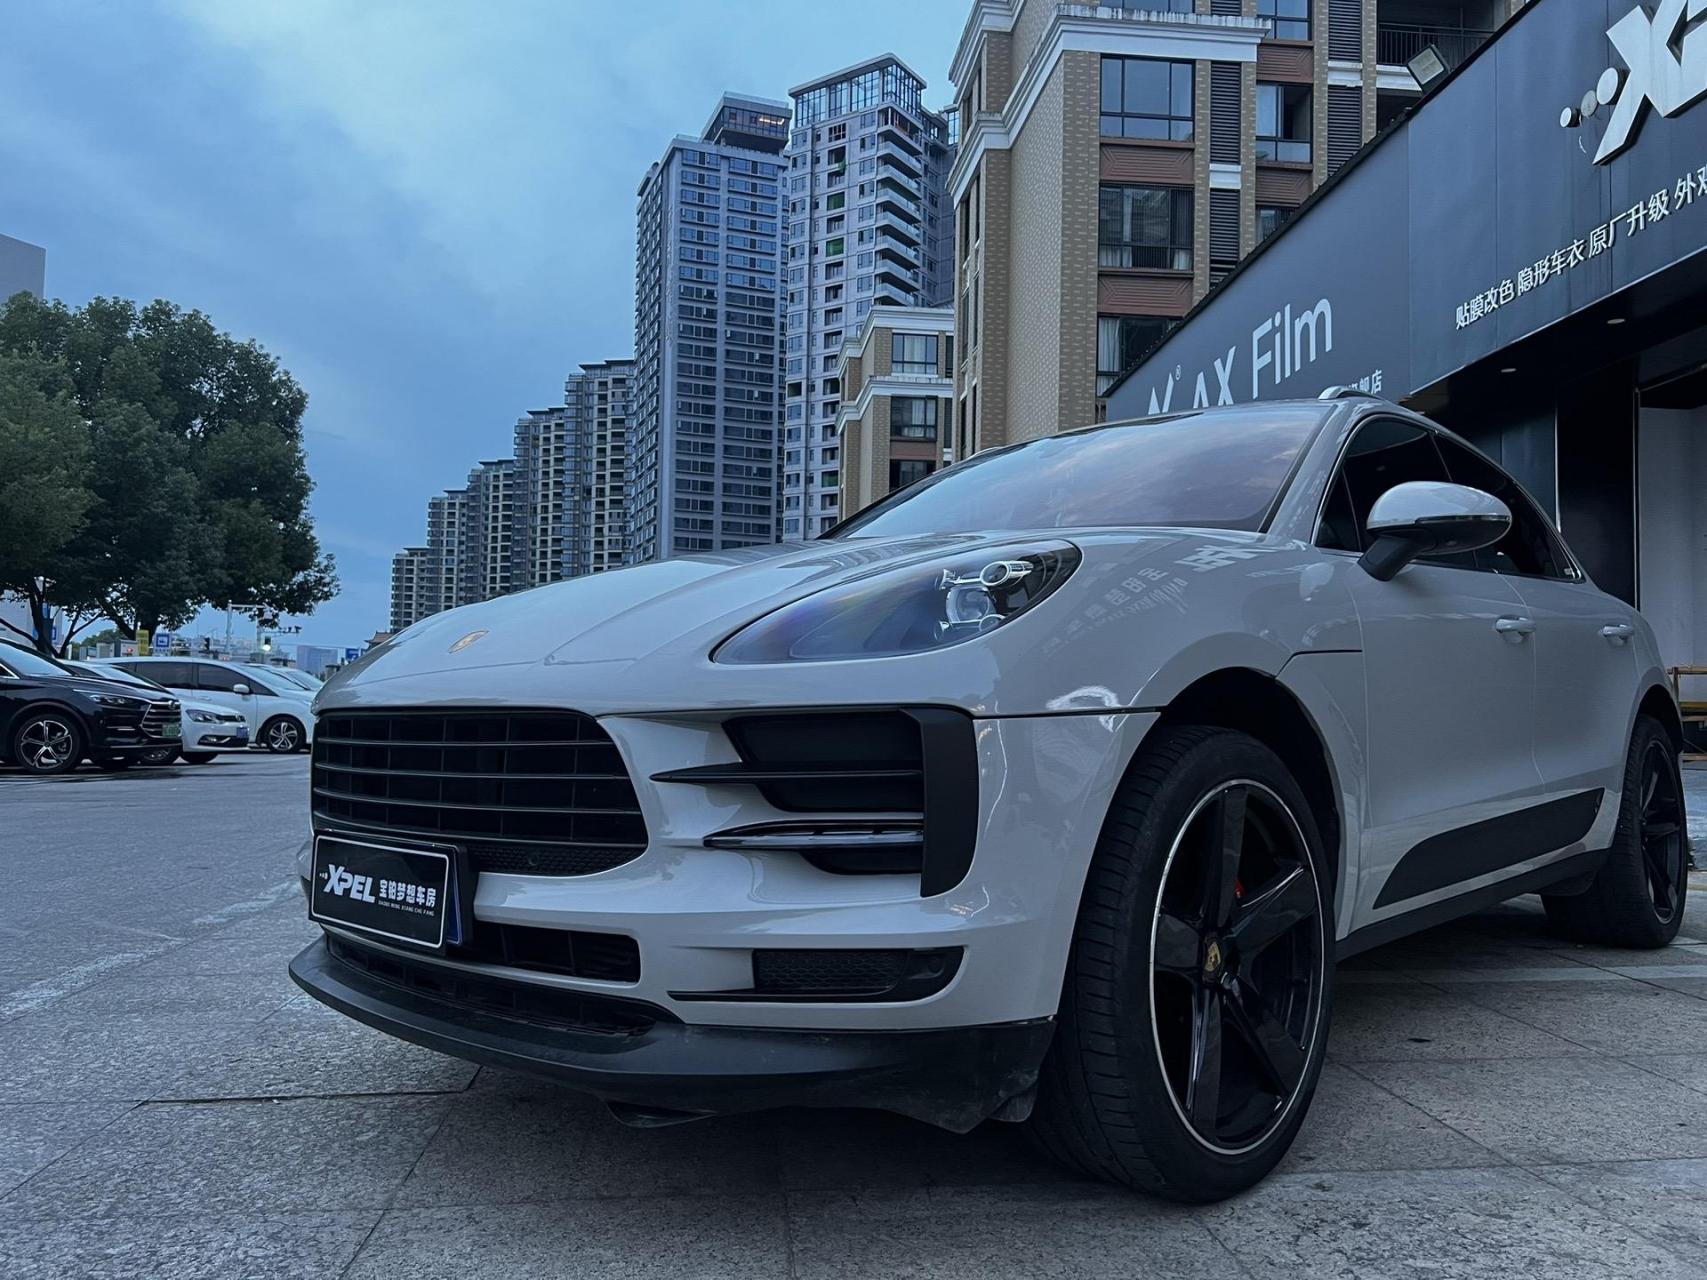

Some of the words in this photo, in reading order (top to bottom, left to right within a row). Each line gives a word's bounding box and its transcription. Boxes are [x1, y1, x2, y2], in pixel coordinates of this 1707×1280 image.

[1456, 279, 1515, 330] 贴膜改色
[1517, 239, 1585, 297] 隐形车衣
[1588, 188, 1669, 259] 原厂升级
[1252, 298, 1333, 400] Film
[323, 864, 376, 904] XPEL
